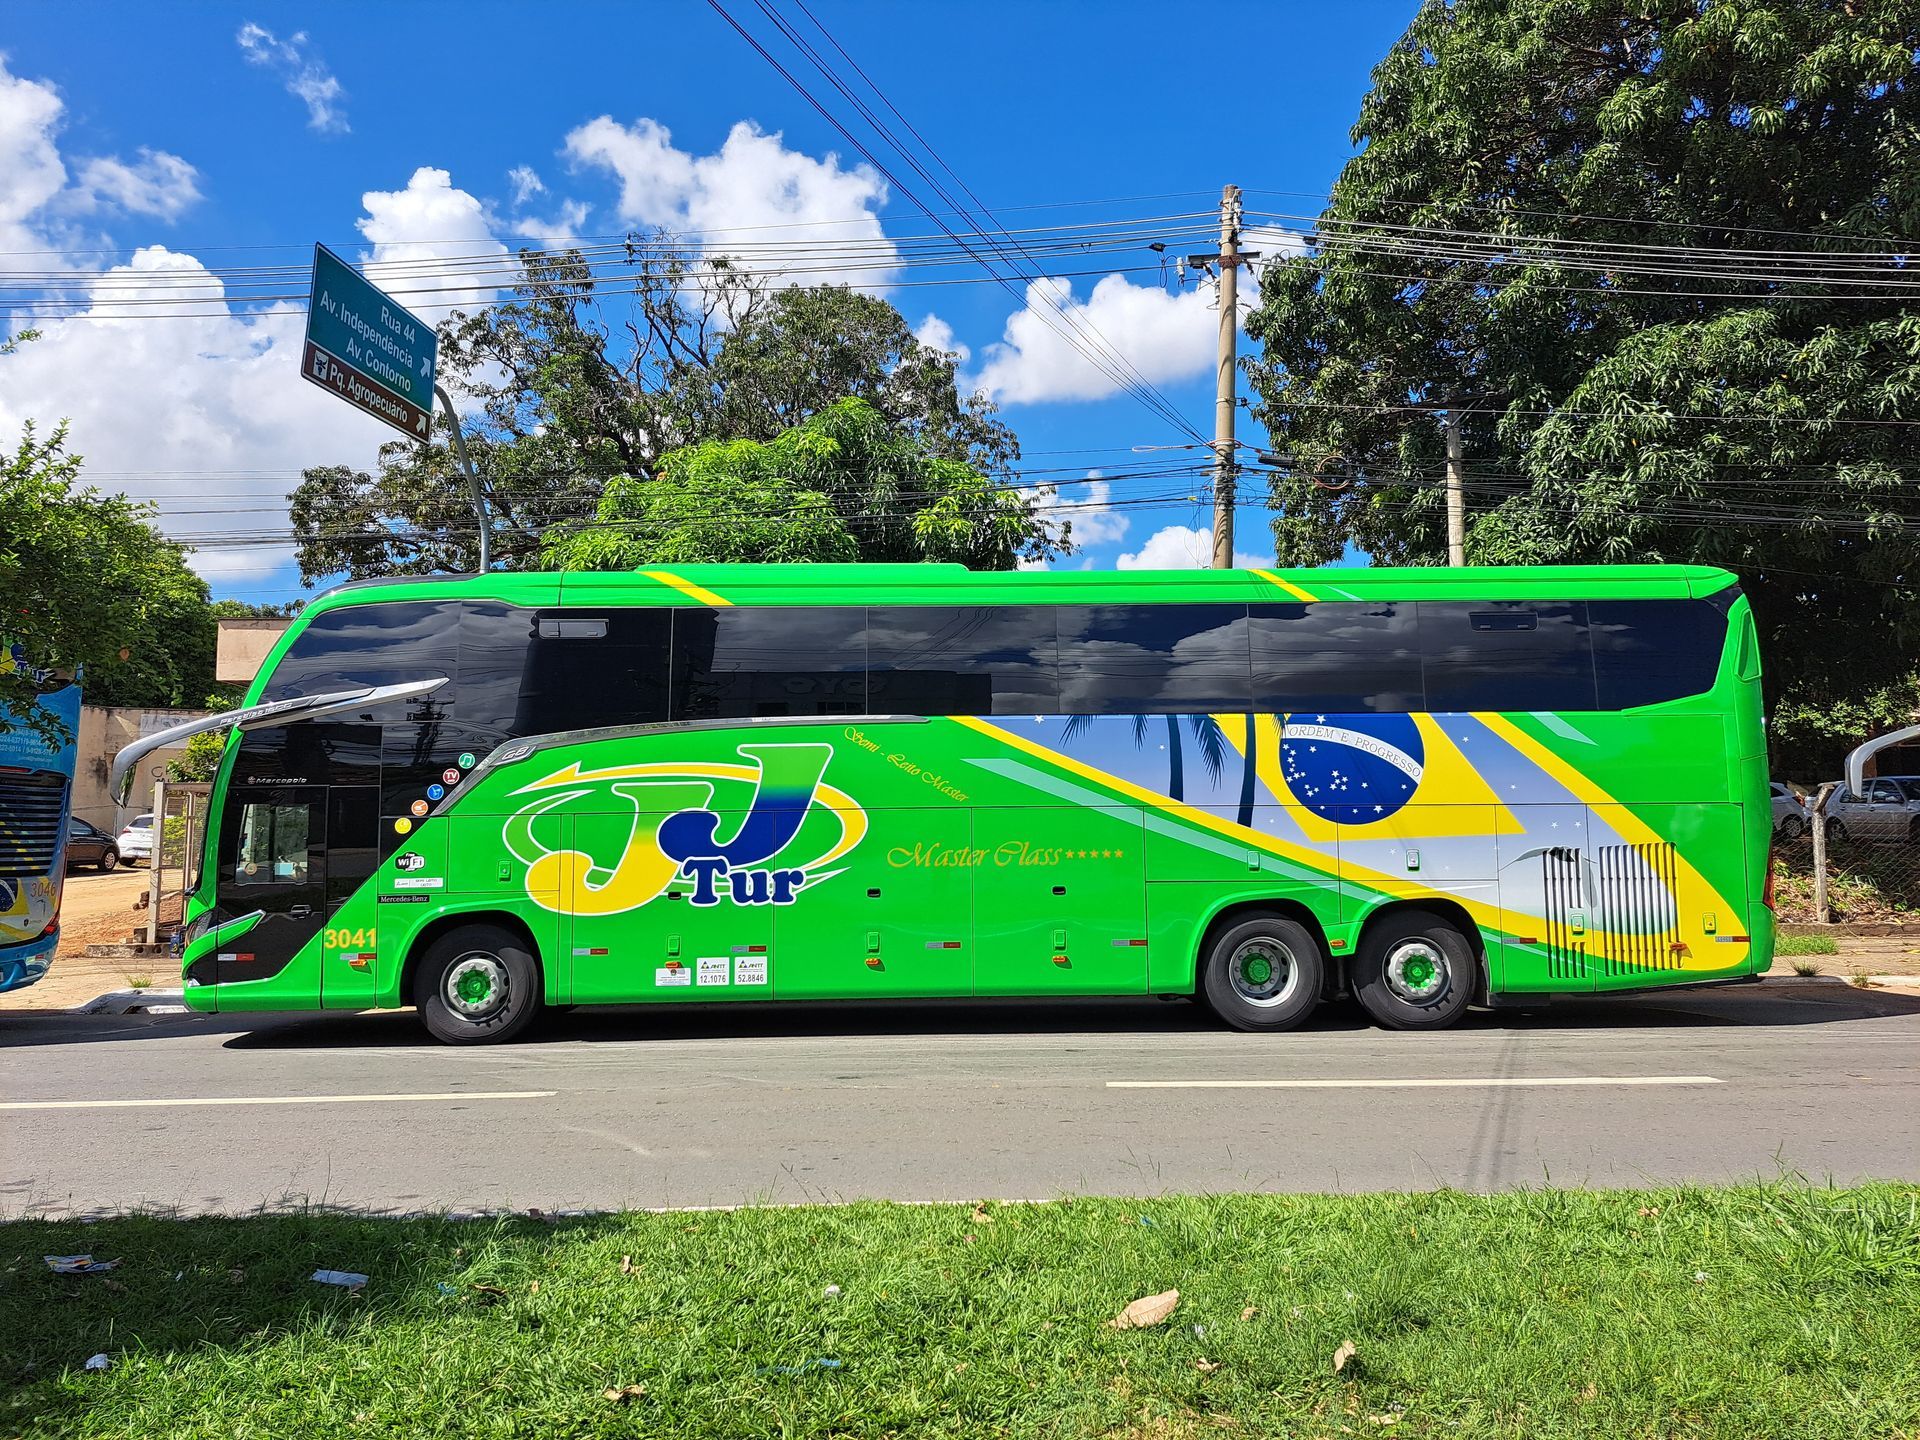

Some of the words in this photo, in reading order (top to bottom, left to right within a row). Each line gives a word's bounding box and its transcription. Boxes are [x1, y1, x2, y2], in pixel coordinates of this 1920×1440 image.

[320, 290, 339, 318] Av.
[340, 303, 413, 369] Independência
[381, 305, 401, 334] Rua
[403, 323, 416, 345] 44
[346, 337, 363, 362] Av.
[365, 350, 411, 392] Contorno
[329, 363, 346, 392] Pq.
[347, 375, 408, 423] Agropecuário
[844, 726, 882, 753] Semi
[921, 771, 969, 802] Master
[1289, 726, 1334, 739] ORDEM
[1341, 732, 1350, 742] E
[1355, 736, 1422, 778] PROGRESSO
[887, 841, 990, 868] Master
[994, 841, 1063, 867] Class
[30, 882, 57, 898] 3046
[380, 895, 428, 903] Mercedes-Benz
[682, 856, 806, 907] Tur
[324, 928, 377, 949] 3041
[700, 974, 727, 983] 12.1076
[737, 974, 764, 983] 52.8846
